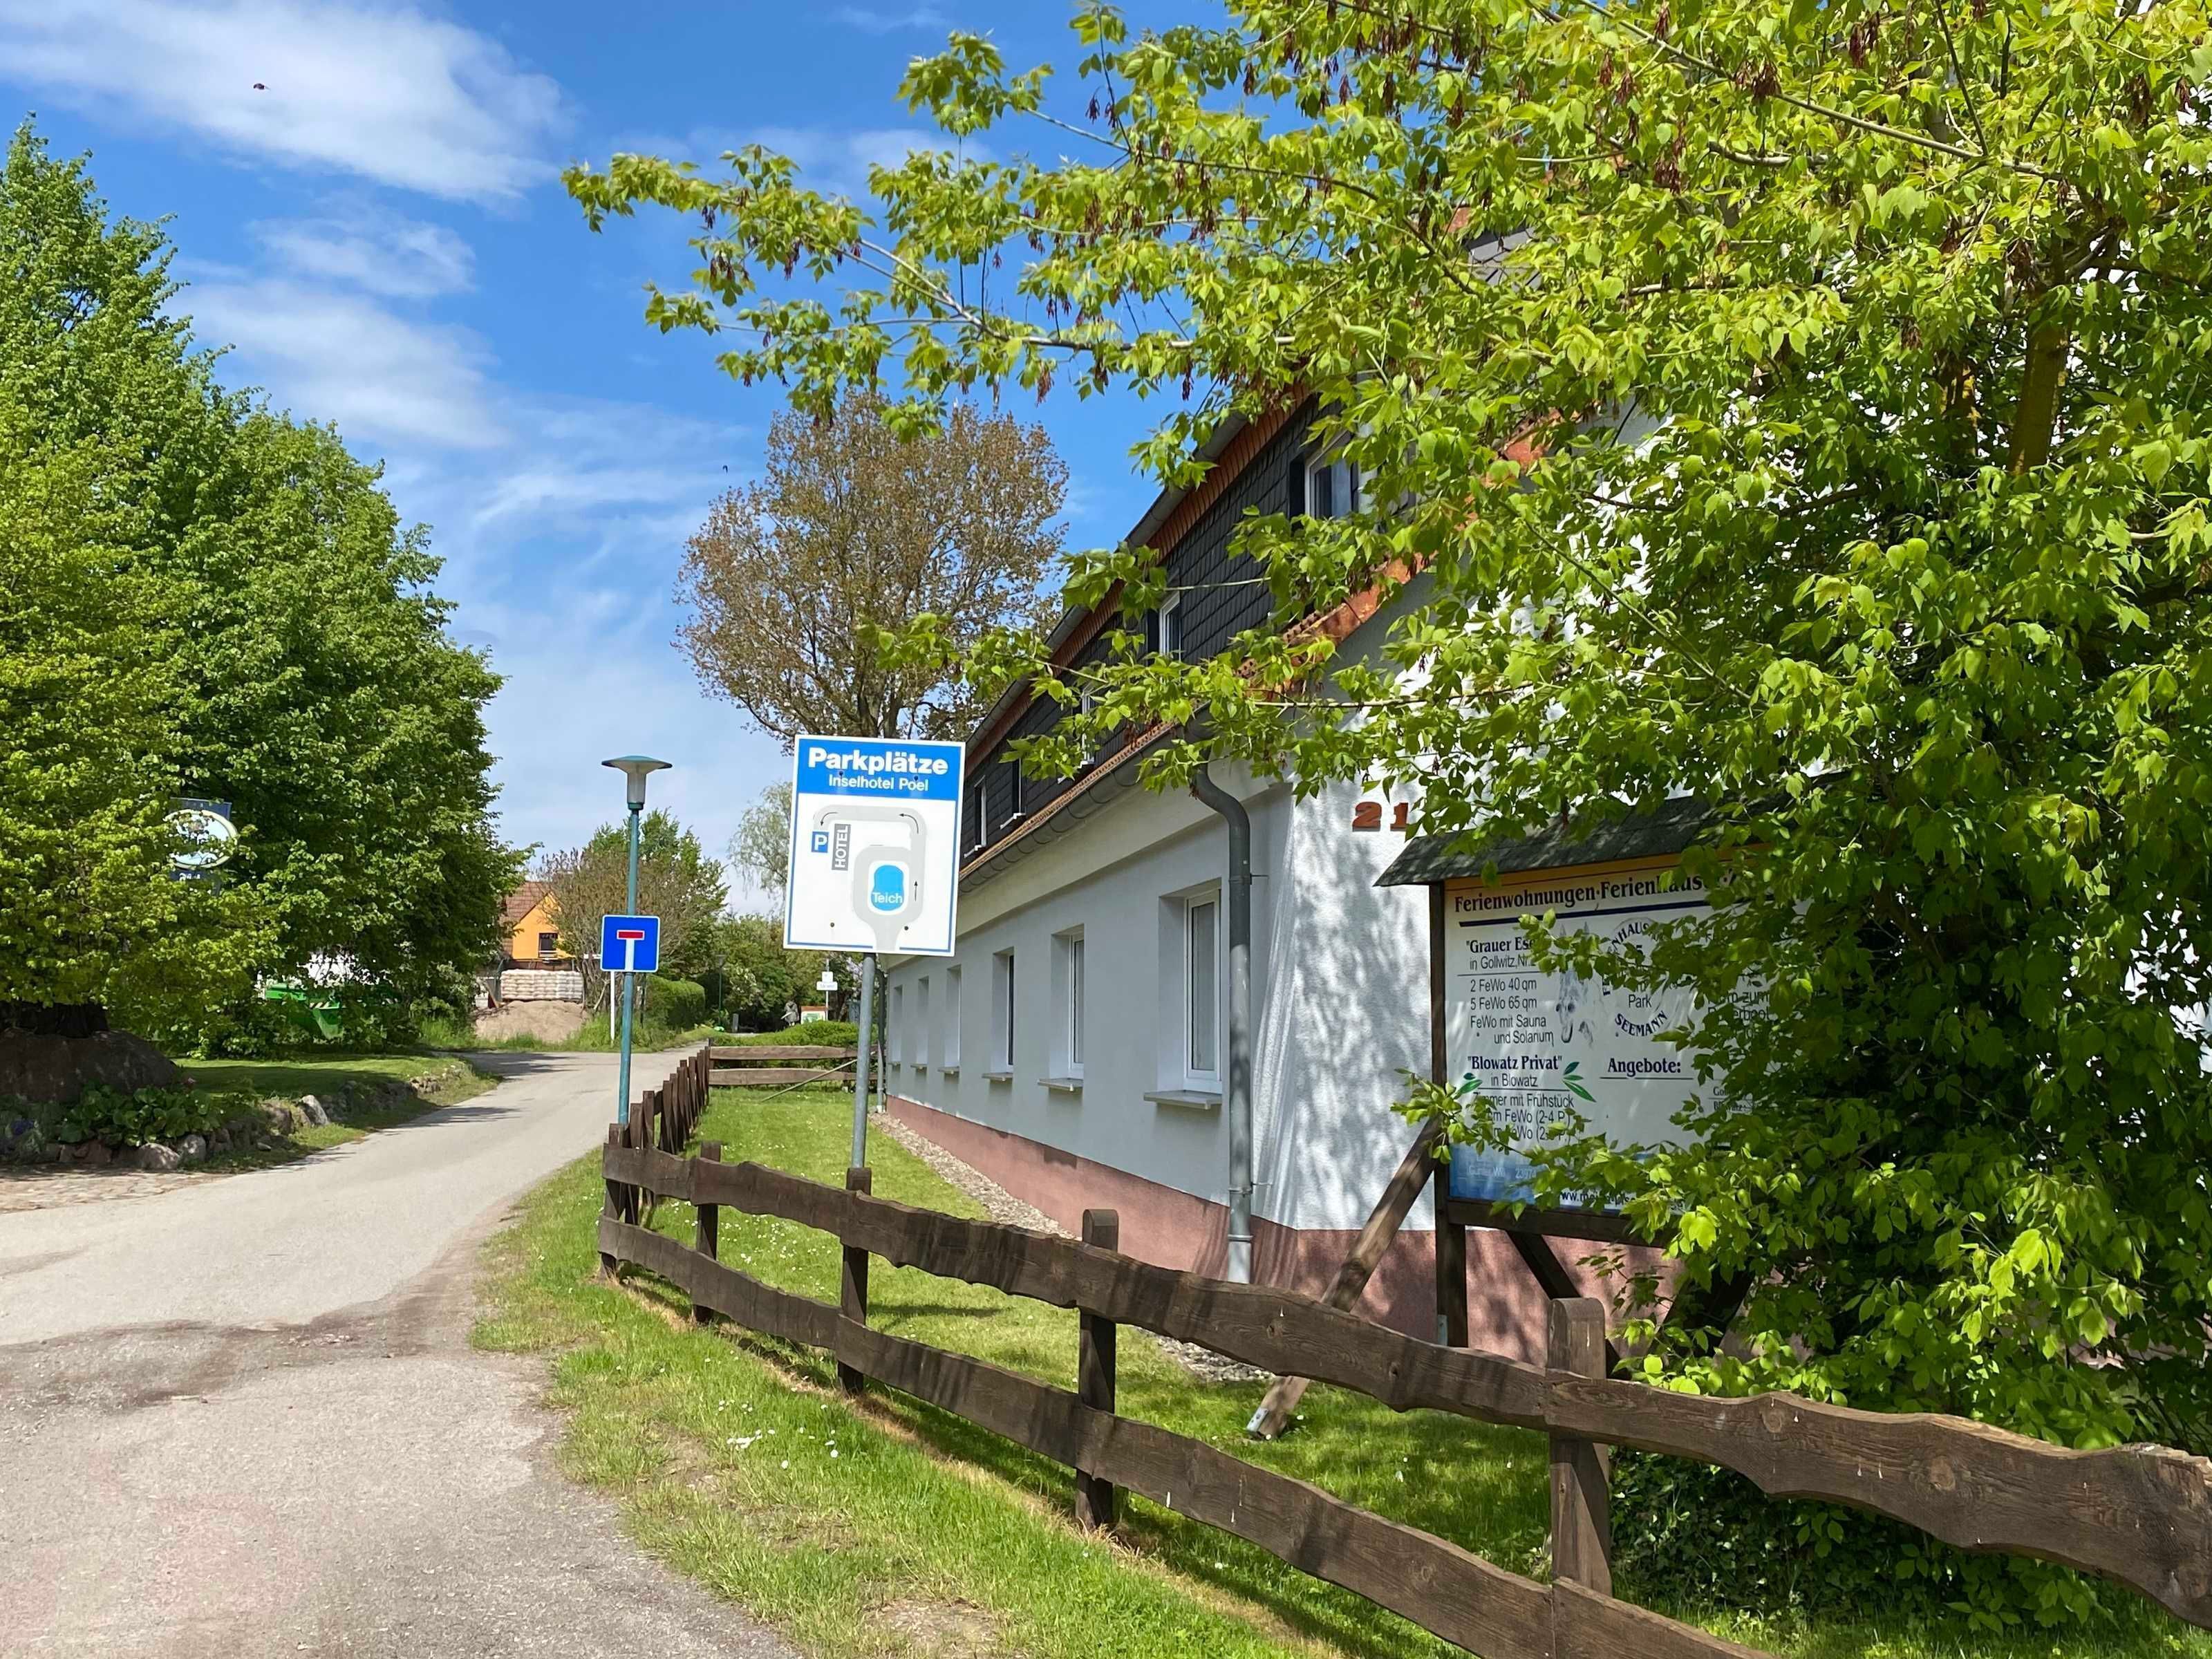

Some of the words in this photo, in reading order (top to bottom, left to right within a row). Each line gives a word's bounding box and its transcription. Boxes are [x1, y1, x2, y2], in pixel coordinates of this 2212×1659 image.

[808, 747, 949, 776] Parkplätze
[829, 774, 894, 790] Inselhotel
[899, 778, 929, 791] Poel
[814, 834, 828, 851] P
[834, 826, 848, 869] HOTEL
[872, 891, 903, 904] Teich
[1470, 957, 1478, 971] in
[1470, 979, 1477, 993] 2
[1479, 978, 1506, 991] FeWo
[1508, 977, 1520, 991] 40
[1521, 979, 1537, 993] qm
[1470, 997, 1477, 1011] 5
[1479, 997, 1506, 1010] FeWo
[1508, 995, 1520, 1009] 65
[1522, 997, 1537, 1012] qm
[1628, 994, 1652, 1009] Park
[1470, 1015, 1497, 1029] FeWo
[1499, 1015, 1513, 1028] mit
[1516, 1014, 1546, 1028] Sauna
[1615, 1010, 1668, 1037] SEEMANN
[1494, 1031, 1511, 1044] und
[1468, 1056, 1519, 1070] "Blowatz
[1521, 1054, 1562, 1070] Privat"
[1608, 1058, 1681, 1077] Angebote:
[1491, 1075, 1499, 1087] in
[1502, 1074, 1538, 1087] Blowatz
[1510, 1095, 1524, 1107] mit
[1526, 1094, 1575, 1107] Frühstück
[1505, 1109, 1533, 1123] FeWo
[1536, 1109, 1555, 1127] (2-4
